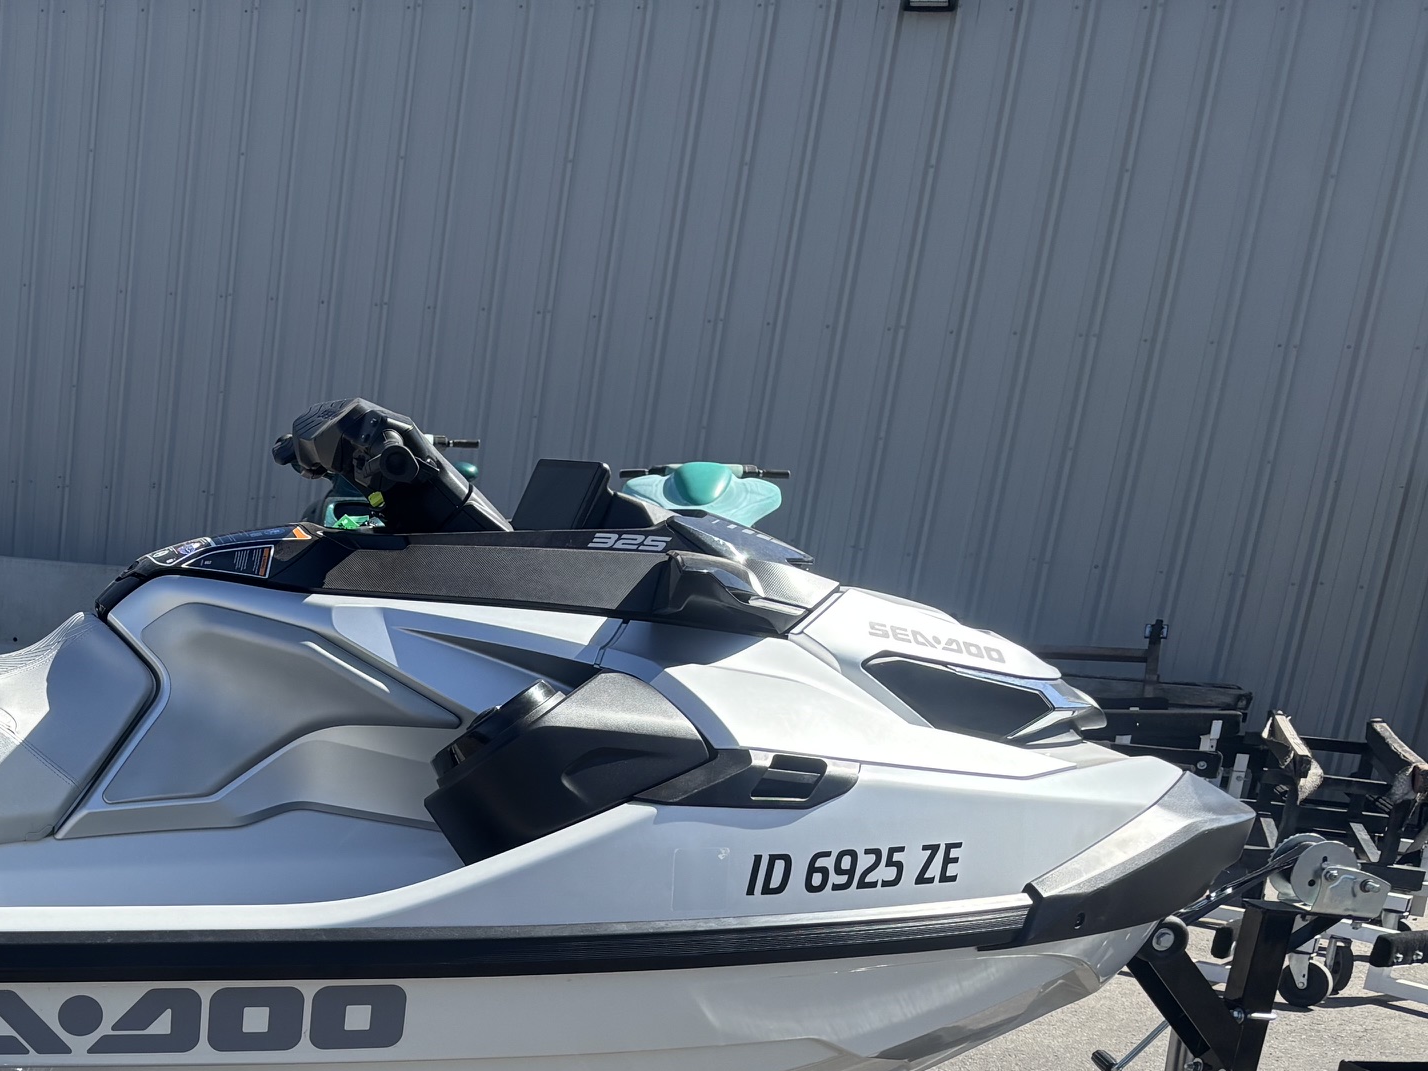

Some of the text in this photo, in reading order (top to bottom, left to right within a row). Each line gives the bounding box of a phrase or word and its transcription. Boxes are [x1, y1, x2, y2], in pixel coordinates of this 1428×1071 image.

[587, 532, 673, 551] 325
[746, 841, 963, 896] ID 6925 ZE
